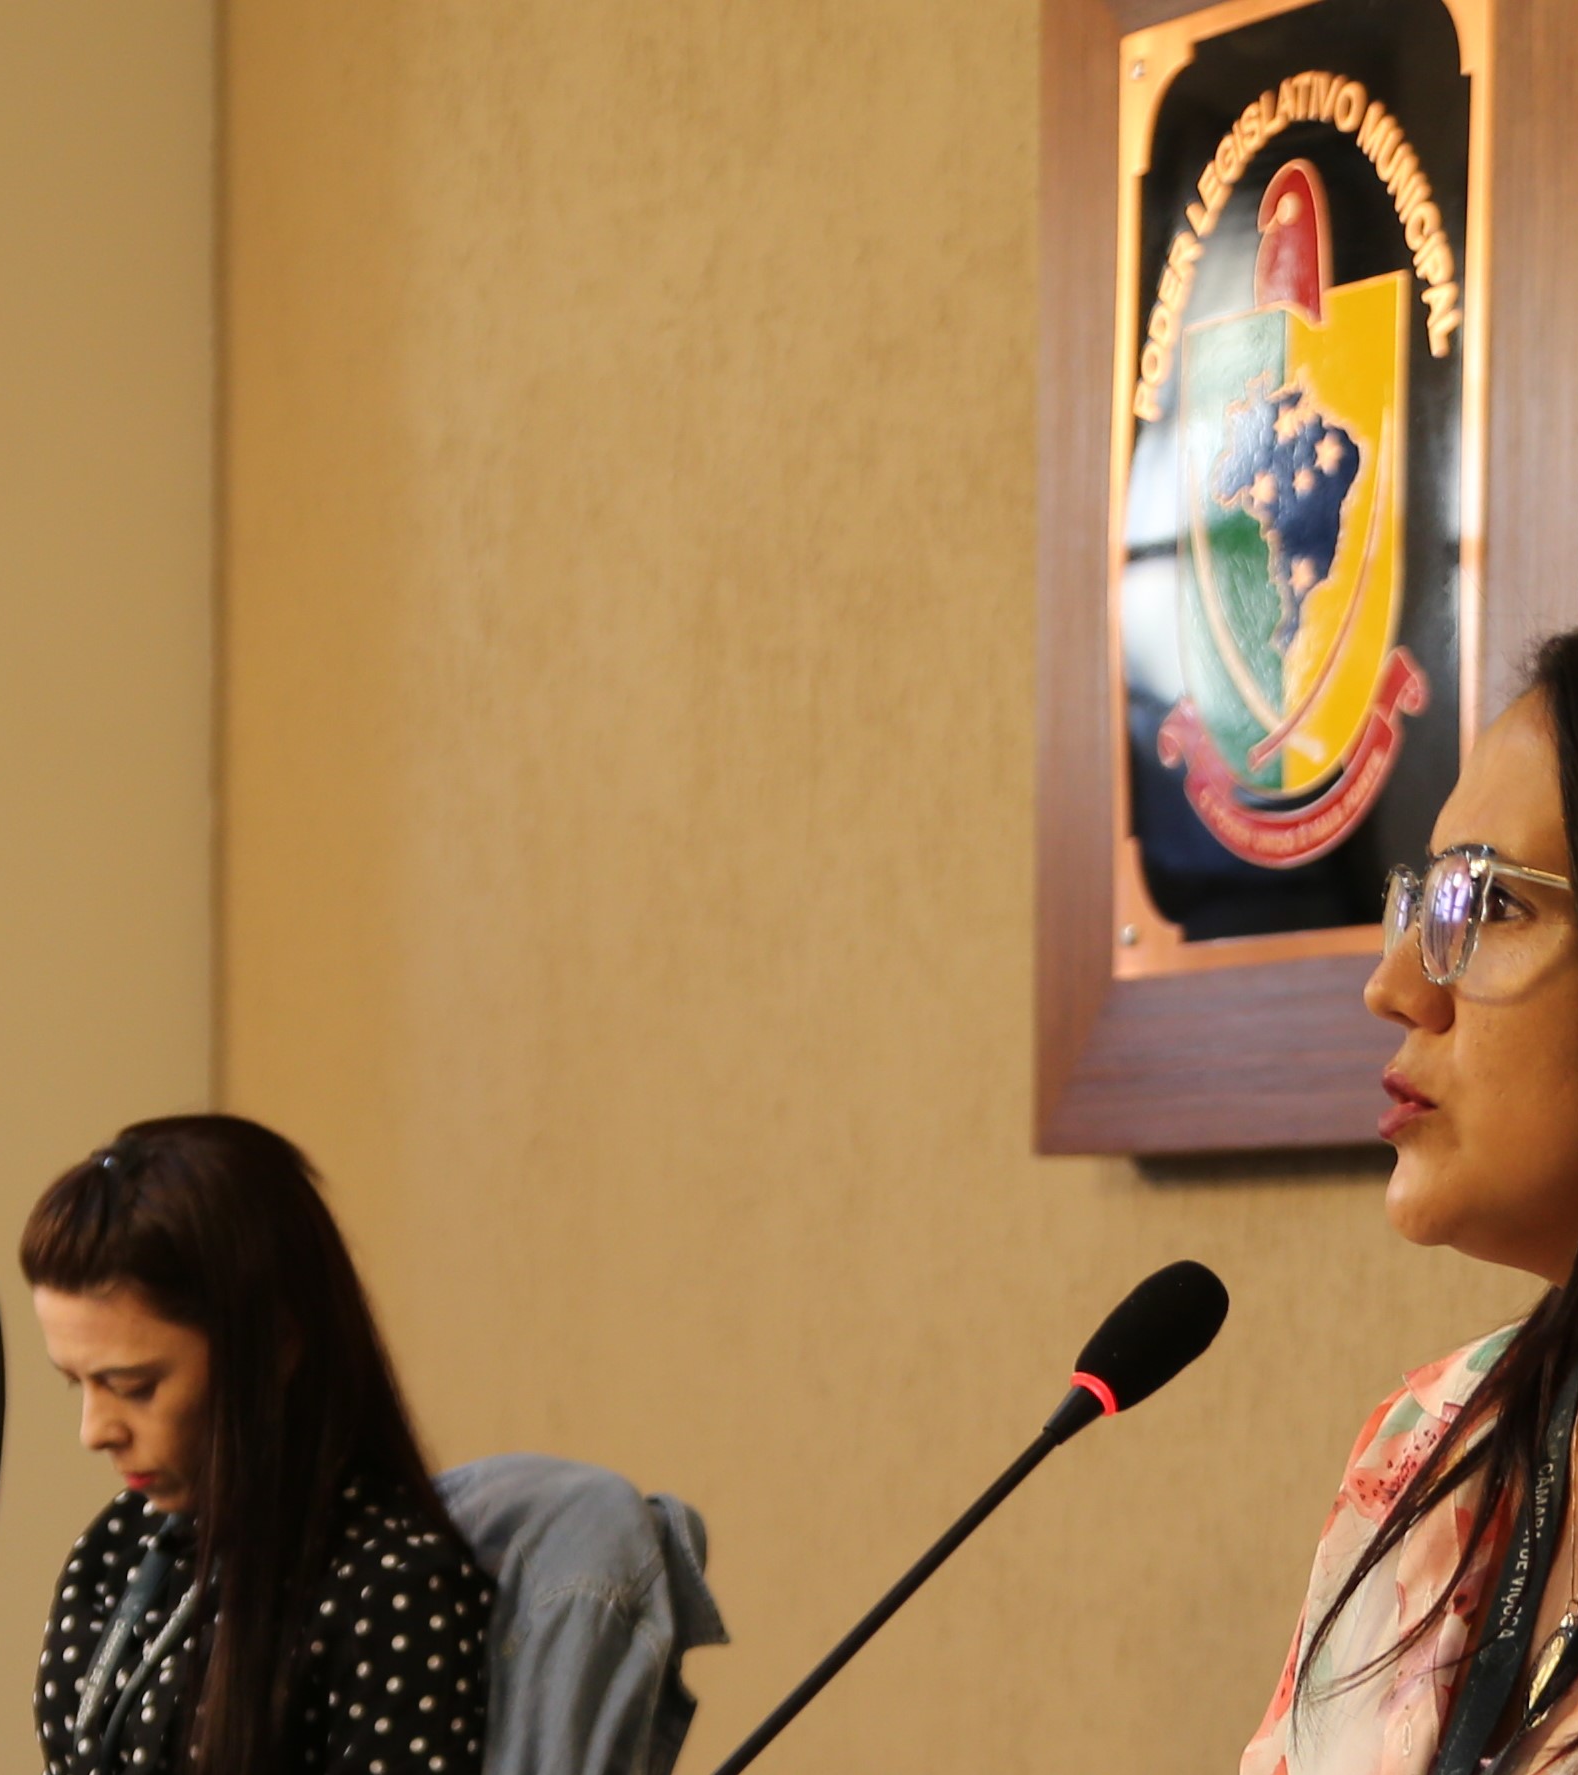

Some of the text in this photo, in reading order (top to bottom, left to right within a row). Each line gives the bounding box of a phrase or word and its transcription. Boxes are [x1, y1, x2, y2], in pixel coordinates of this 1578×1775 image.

[1133, 69, 1463, 423] PODER LEGISLATIVO MUNICIPAL
